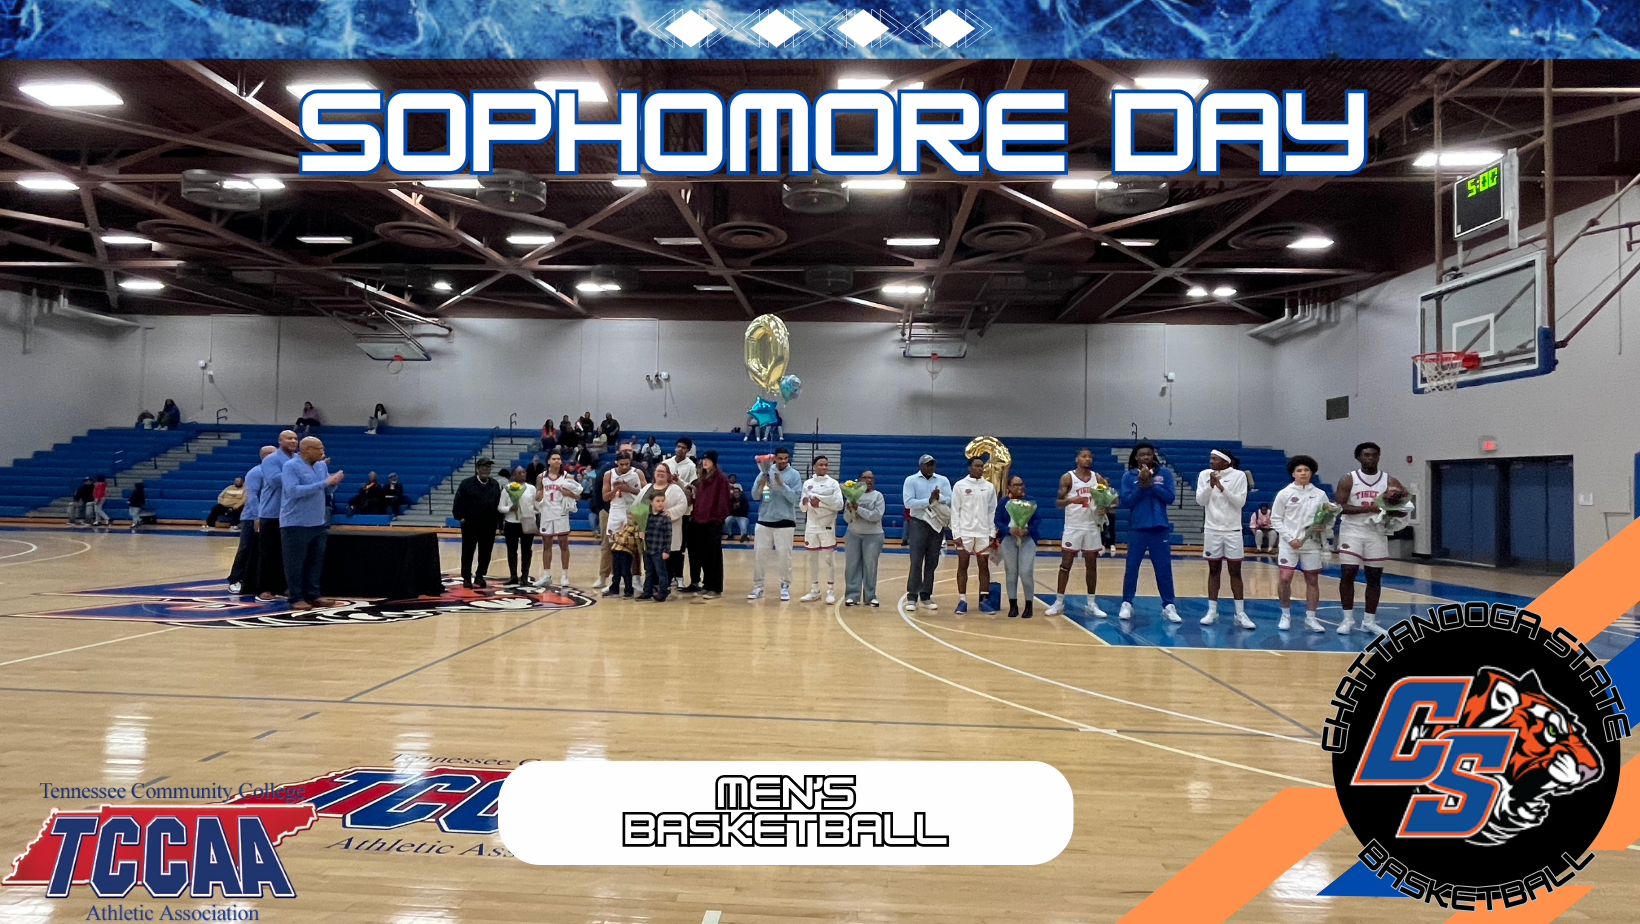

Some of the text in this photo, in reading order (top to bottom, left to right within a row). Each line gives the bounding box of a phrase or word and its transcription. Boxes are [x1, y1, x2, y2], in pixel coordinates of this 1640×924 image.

[1467, 167, 1498, 198] 5:00
[391, 753, 511, 766] Tennessee
[325, 836, 515, 858] Athletic Ass
